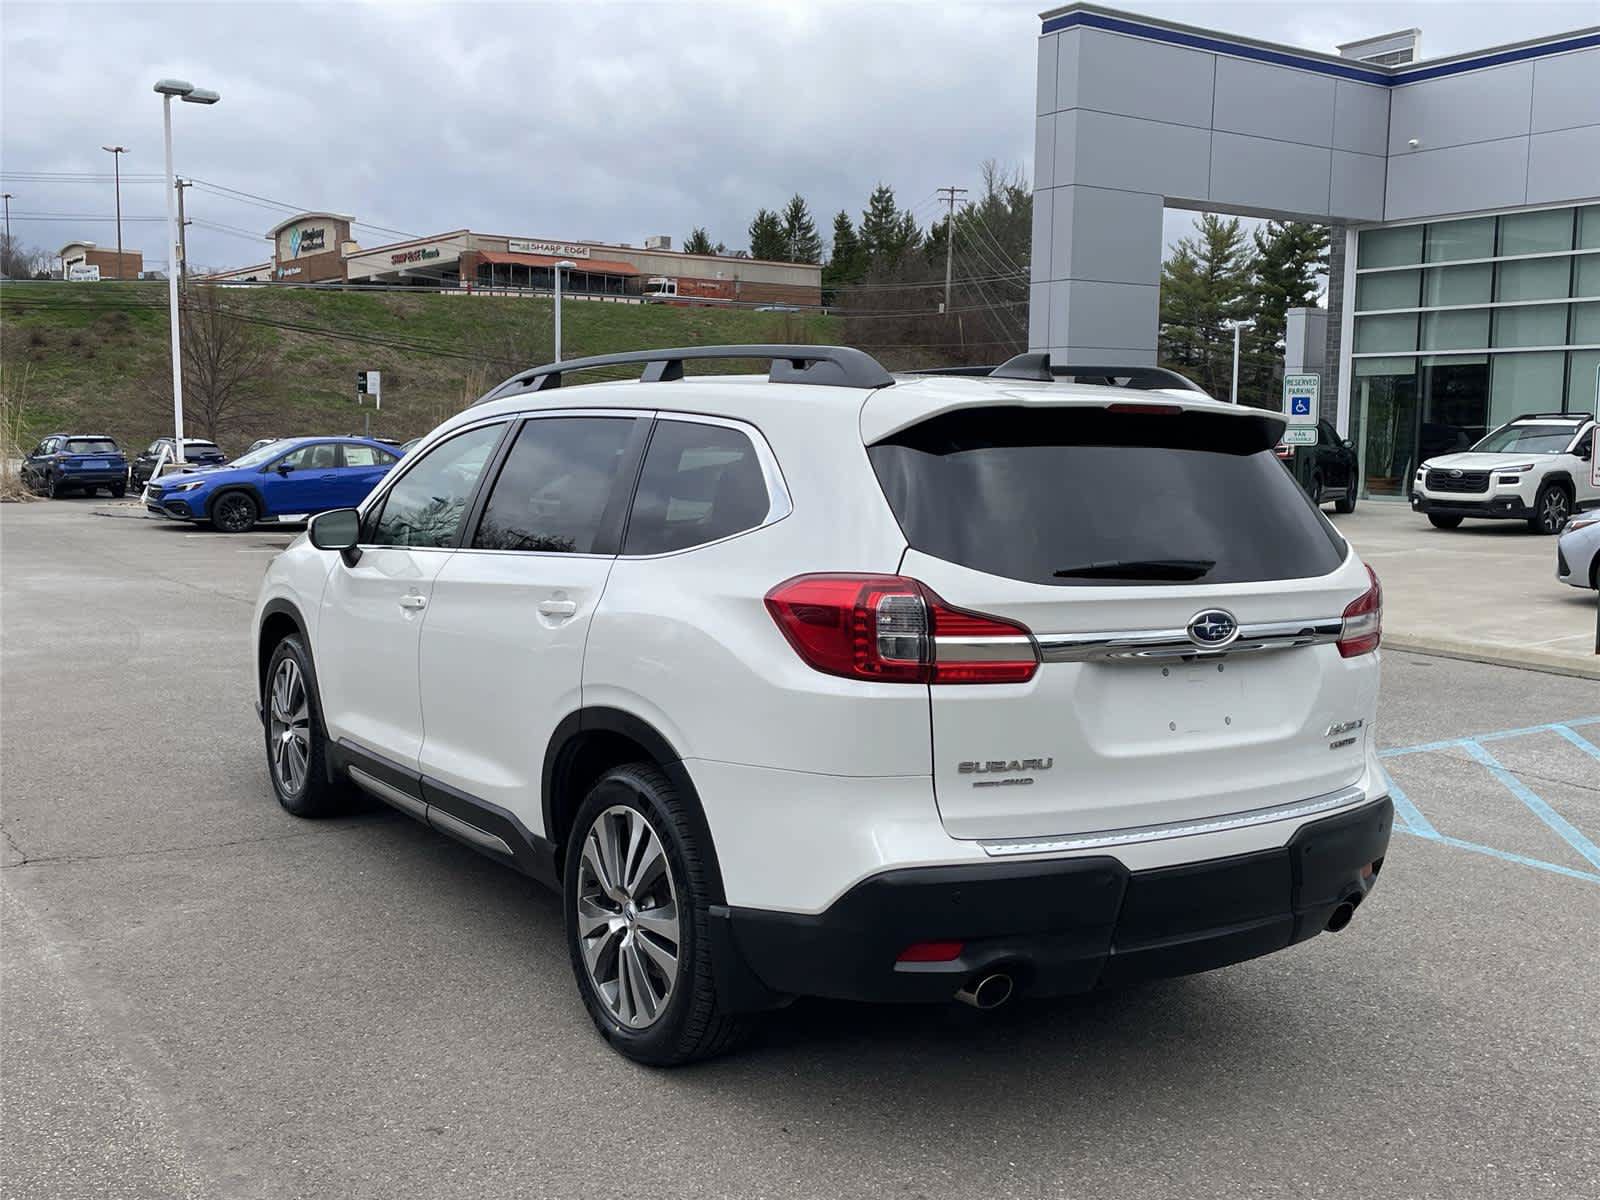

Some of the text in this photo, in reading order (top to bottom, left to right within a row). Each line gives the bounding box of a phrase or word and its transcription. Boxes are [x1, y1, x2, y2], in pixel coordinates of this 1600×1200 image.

[530, 242, 561, 253] SHARP
[564, 245, 588, 256] EDGE
[1287, 387, 1316, 395] PARKING
[958, 757, 1053, 775] SUBARU
